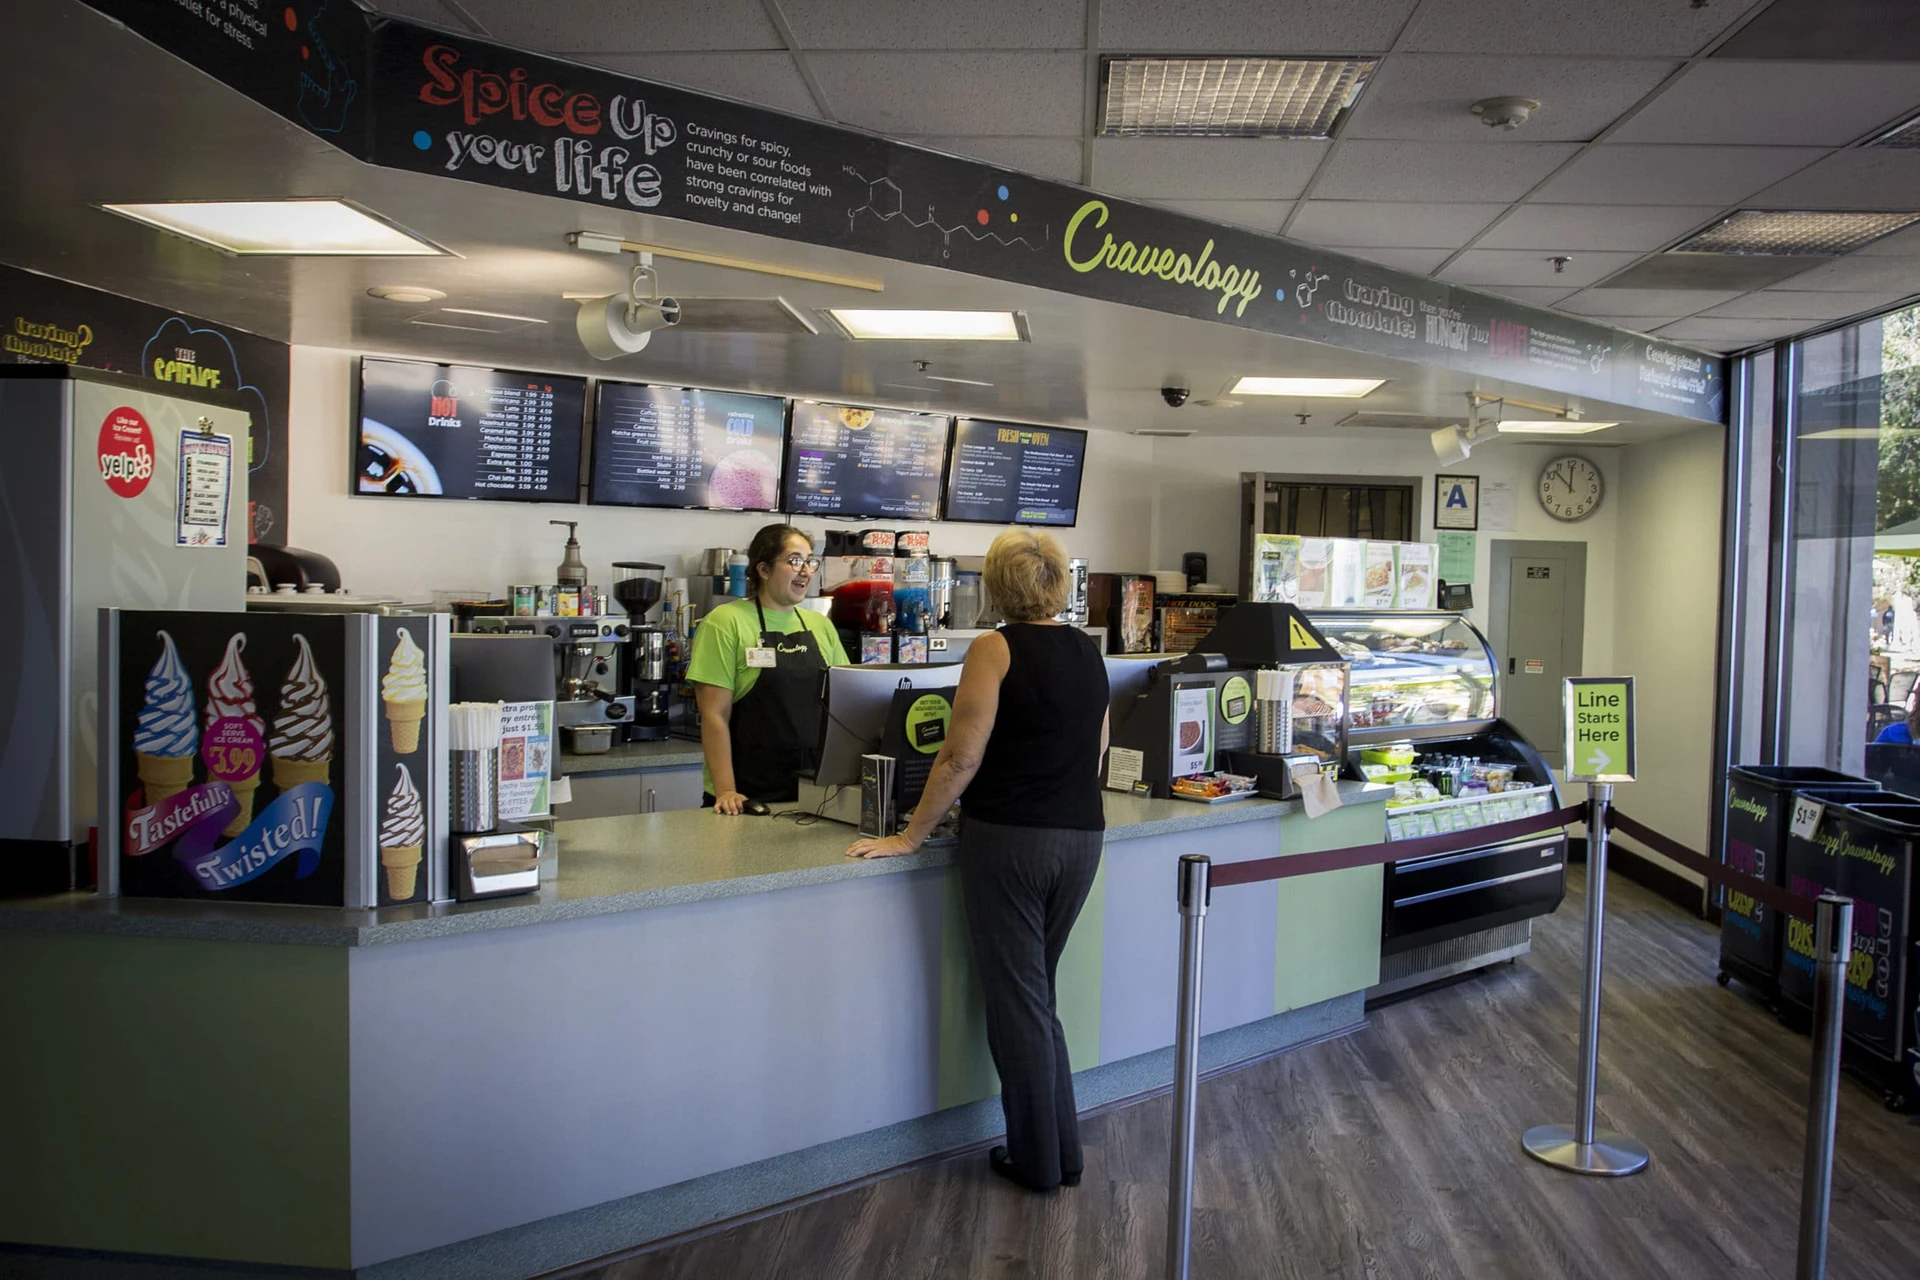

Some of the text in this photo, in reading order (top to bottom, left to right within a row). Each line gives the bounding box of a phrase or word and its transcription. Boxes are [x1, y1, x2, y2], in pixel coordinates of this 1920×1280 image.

[206, 7, 222, 28] for
[223, 21, 255, 51] stress.
[229, 3, 268, 37] physical
[418, 44, 677, 155] Spice Up
[686, 123, 791, 157] Cravings for spicy,
[686, 141, 811, 177] crunchy or sour foods
[444, 131, 662, 207] your life
[686, 157, 832, 197] have been correlated with
[686, 176, 793, 205] strong cravings for
[686, 193, 801, 224] novelty and change!
[1064, 200, 1262, 318] Craveology
[1343, 277, 1414, 317] Craving
[1419, 300, 1437, 315] then
[1325, 299, 1416, 339] Chocolate?
[1425, 314, 1470, 352] HUNGRY
[175, 347, 196, 363] THE
[430, 396, 460, 418] HOT
[428, 417, 462, 428] Drinks
[727, 418, 754, 437] COLD
[997, 428, 1050, 446] FRESH OVEN
[101, 452, 136, 483] yelp
[1567, 460, 1577, 469] 12
[1580, 464, 1584, 472] 1
[1546, 471, 1556, 480] 10
[1588, 472, 1595, 481] 2
[1446, 484, 1468, 508] A
[1543, 483, 1550, 492] 9
[1591, 485, 1598, 494] 3
[1546, 496, 1552, 504] 8
[1554, 504, 1561, 514] 7
[1586, 496, 1592, 504] 4
[1566, 508, 1572, 516] 6
[1577, 505, 1584, 514] 5
[1188, 600, 1218, 608] DOGS
[900, 677, 912, 689] hp
[502, 703, 550, 713] tra protein
[1578, 691, 1620, 707] Line
[500, 713, 541, 724] ny entrée
[1578, 712, 1620, 724] Starts
[502, 723, 545, 735] just $1.50
[1578, 728, 1620, 742] Here
[1729, 787, 1768, 822] Craveology
[129, 787, 231, 852] Tastefully
[1795, 806, 1818, 825] $1.99
[196, 796, 323, 887] Twisted!
[1840, 830, 1896, 876] Craveology
[1788, 916, 1816, 958] CRIS
